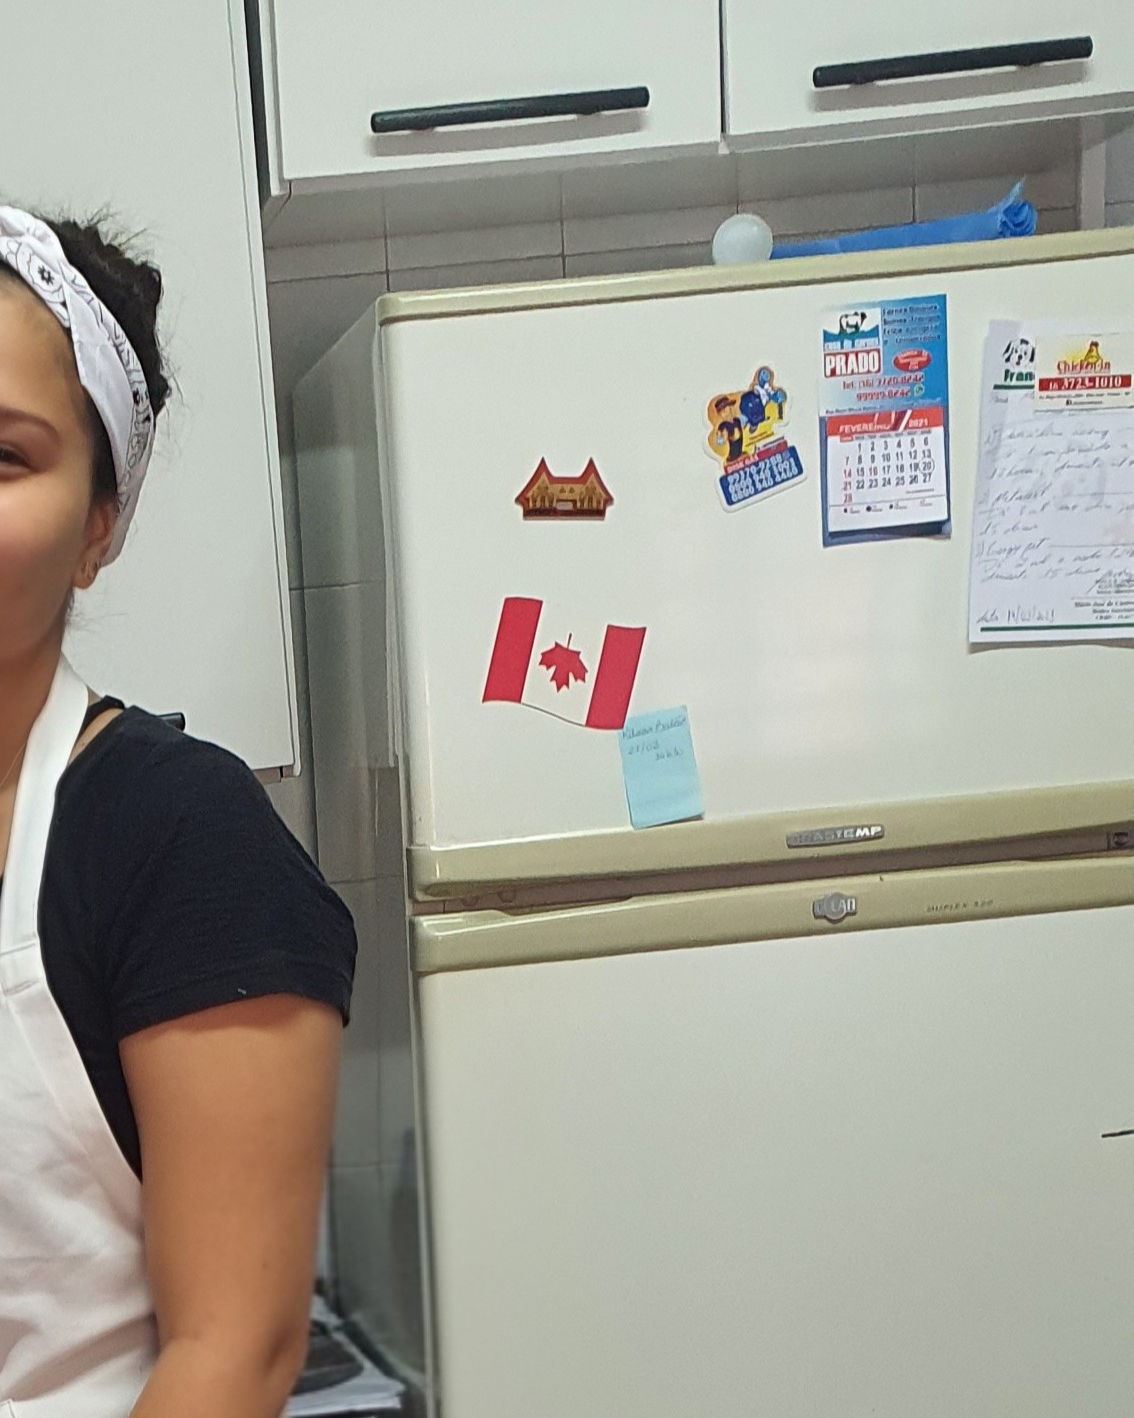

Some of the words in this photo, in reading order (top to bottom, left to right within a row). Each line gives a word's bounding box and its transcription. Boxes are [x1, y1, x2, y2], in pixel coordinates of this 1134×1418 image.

[825, 351, 880, 377] PRADO
[882, 453, 891, 463] 10
[896, 452, 904, 461] 11
[909, 450, 918, 460] 12
[922, 449, 932, 459] 13
[844, 469, 852, 478] 14
[856, 467, 865, 477] 15
[882, 465, 891, 475] 17
[909, 462, 919, 472] 19
[922, 461, 932, 471] 20
[856, 480, 865, 490] 22
[868, 478, 879, 488] 23
[882, 477, 892, 487] 24
[922, 473, 932, 483] 27
